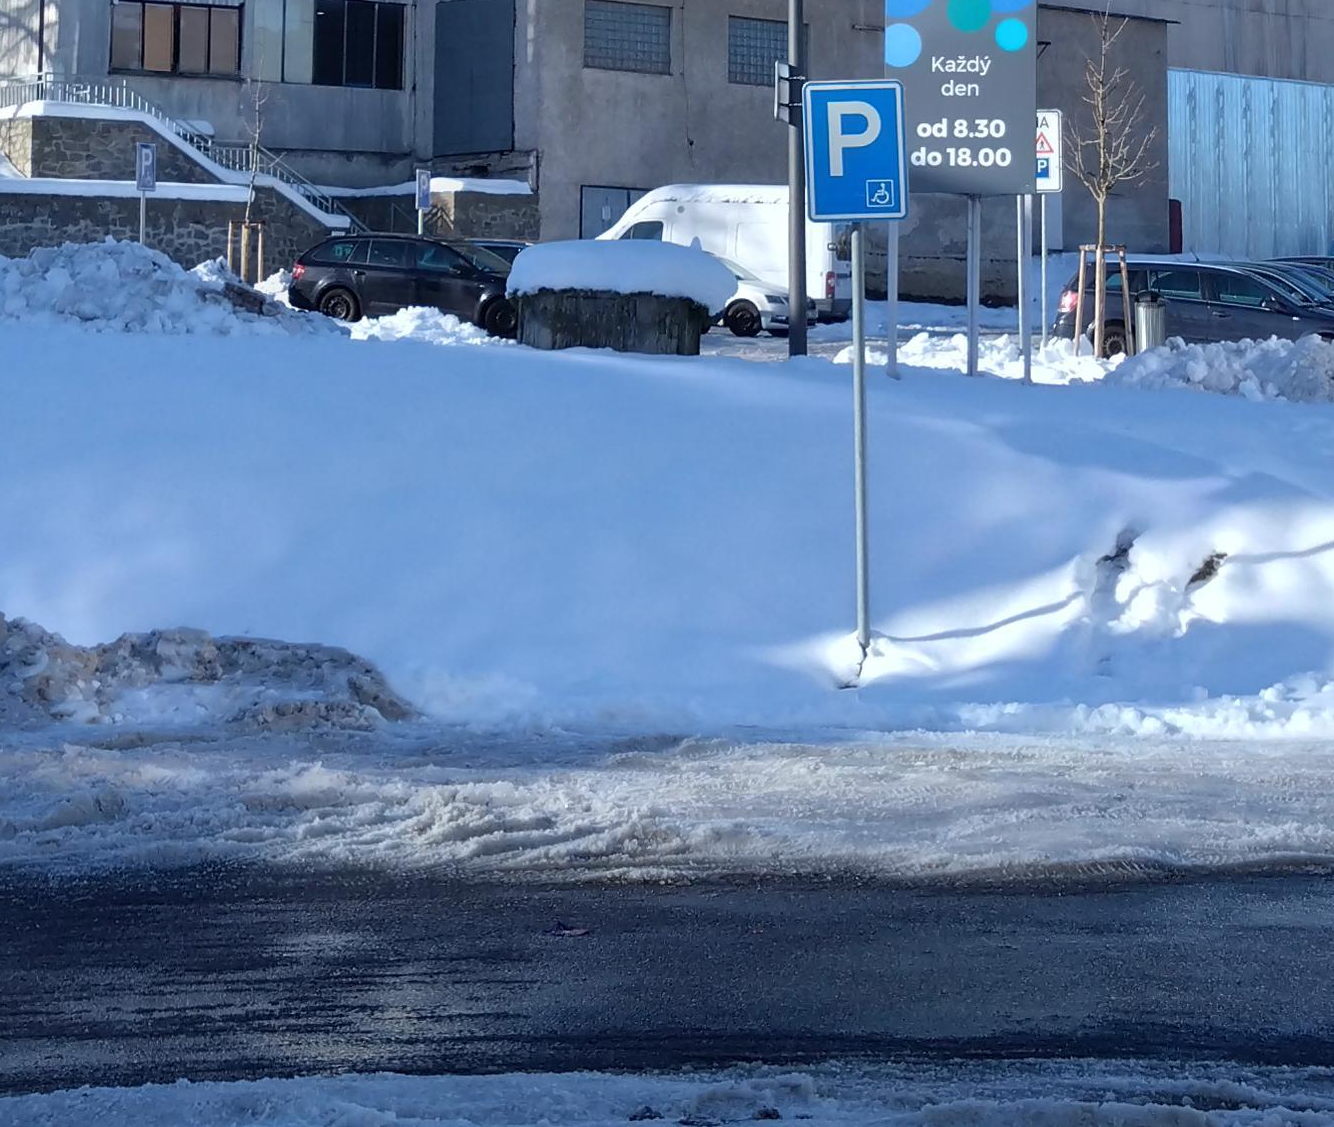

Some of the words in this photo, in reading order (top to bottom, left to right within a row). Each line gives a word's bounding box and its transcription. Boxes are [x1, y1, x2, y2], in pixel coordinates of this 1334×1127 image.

[931, 55, 991, 76] Každý
[941, 79, 980, 96] den
[827, 100, 881, 177] P
[916, 118, 948, 138] od
[953, 119, 1006, 138] 8.30
[141, 148, 153, 176] P
[910, 146, 943, 166] do
[946, 147, 1012, 167] 18.00
[1037, 159, 1048, 174] P
